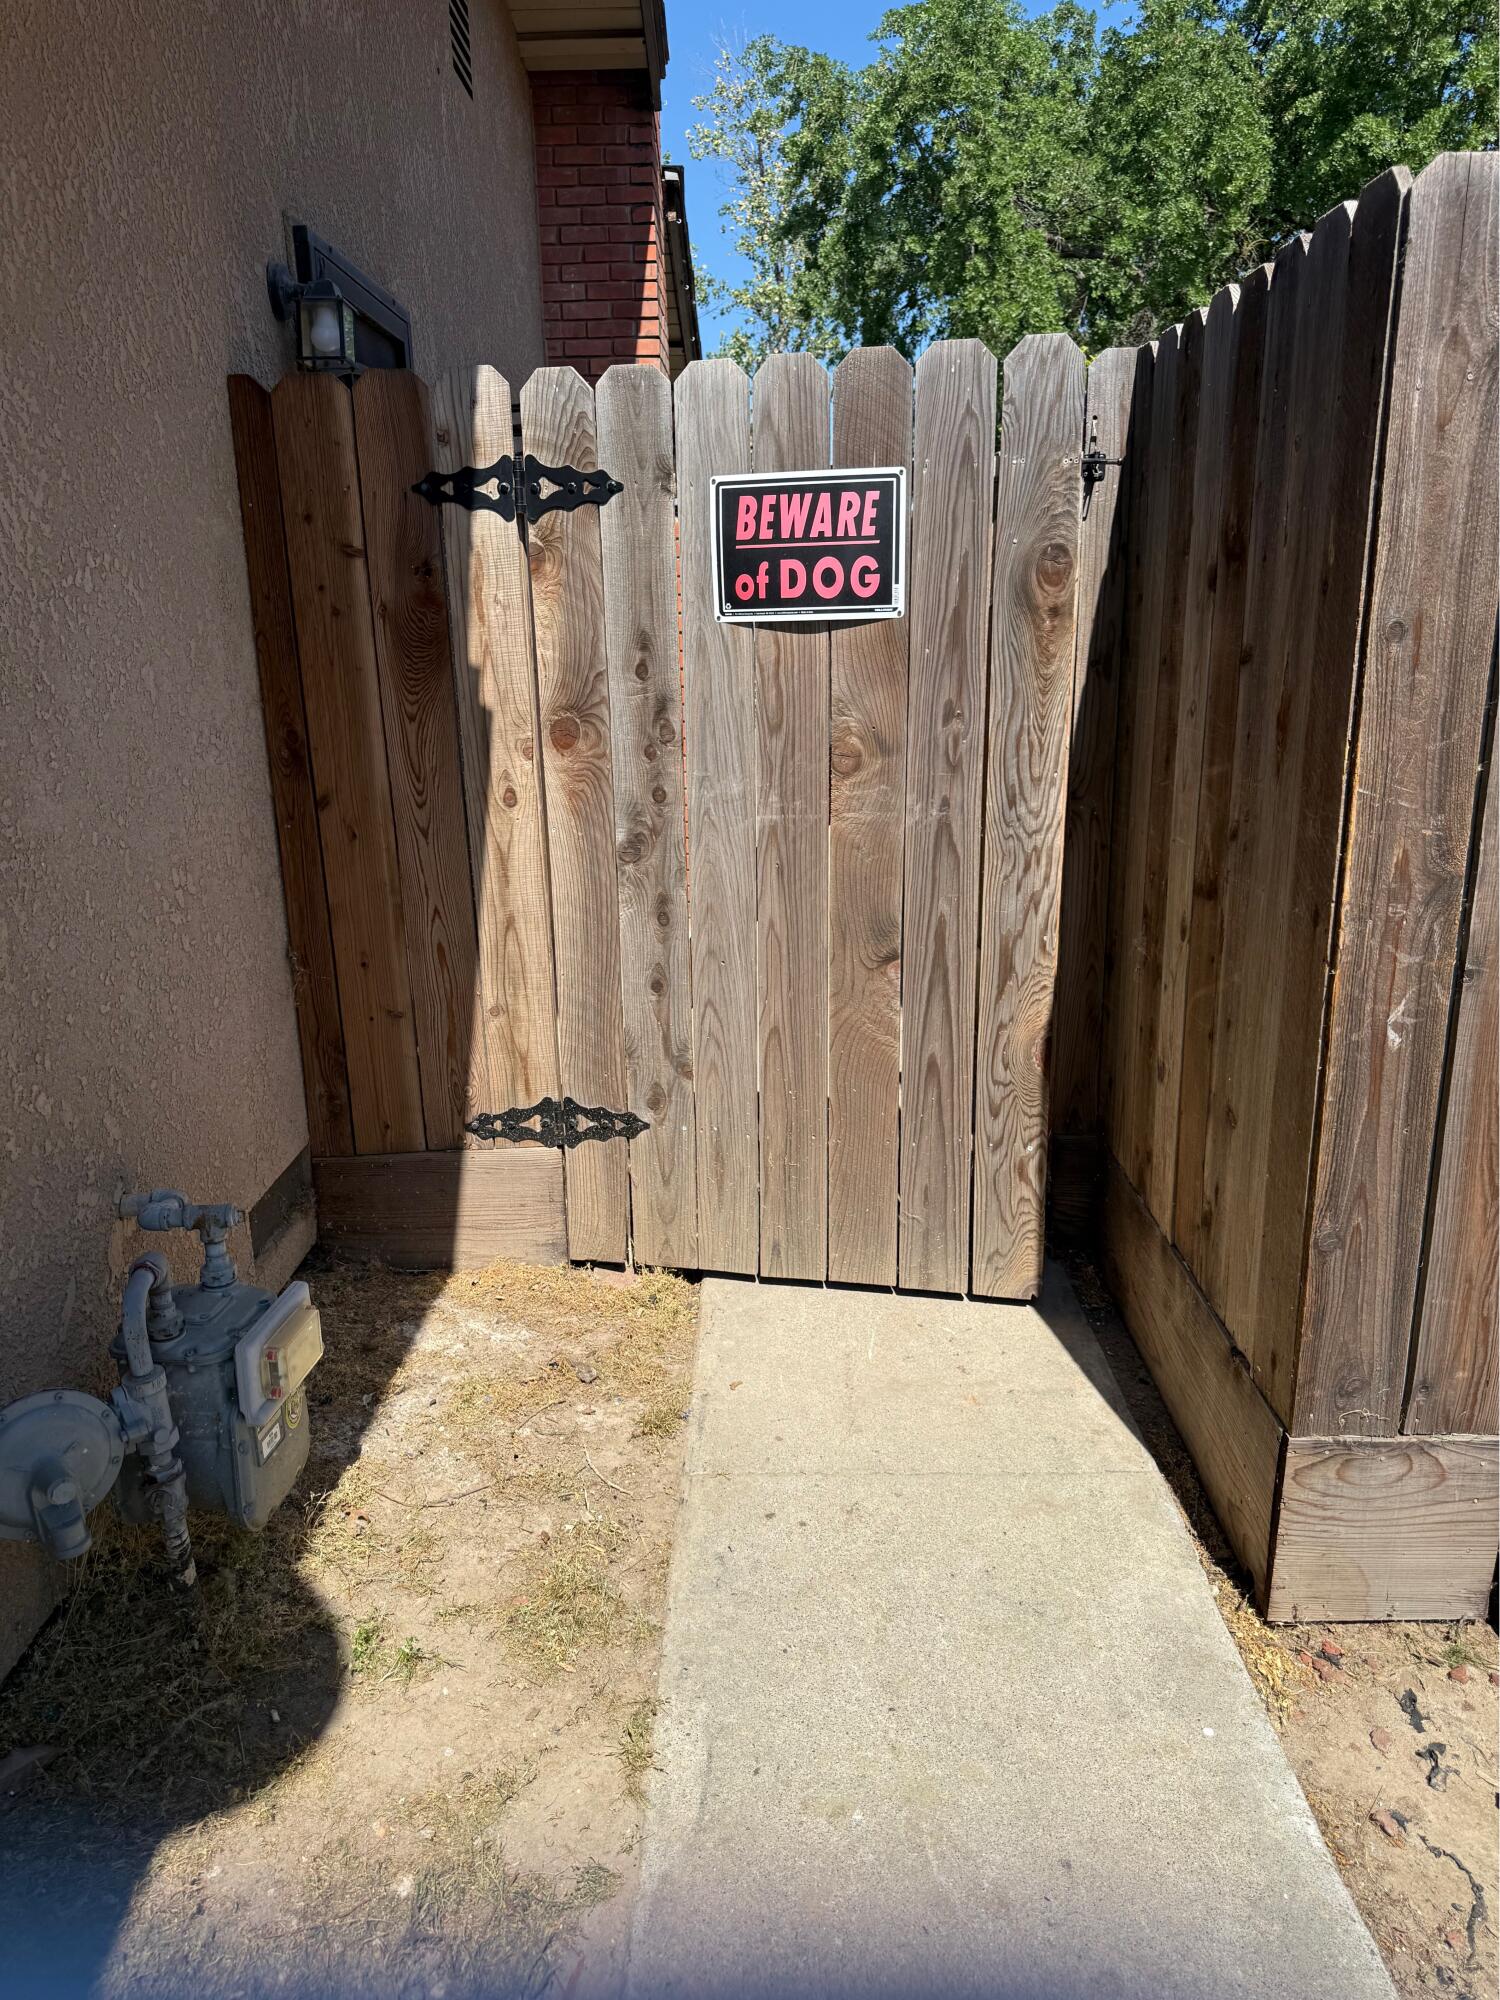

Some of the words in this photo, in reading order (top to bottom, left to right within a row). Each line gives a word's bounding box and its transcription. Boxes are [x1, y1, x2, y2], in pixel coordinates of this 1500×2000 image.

[736, 490, 880, 541] BEWARE
[735, 561, 769, 600] of
[780, 555, 881, 599] DOG
